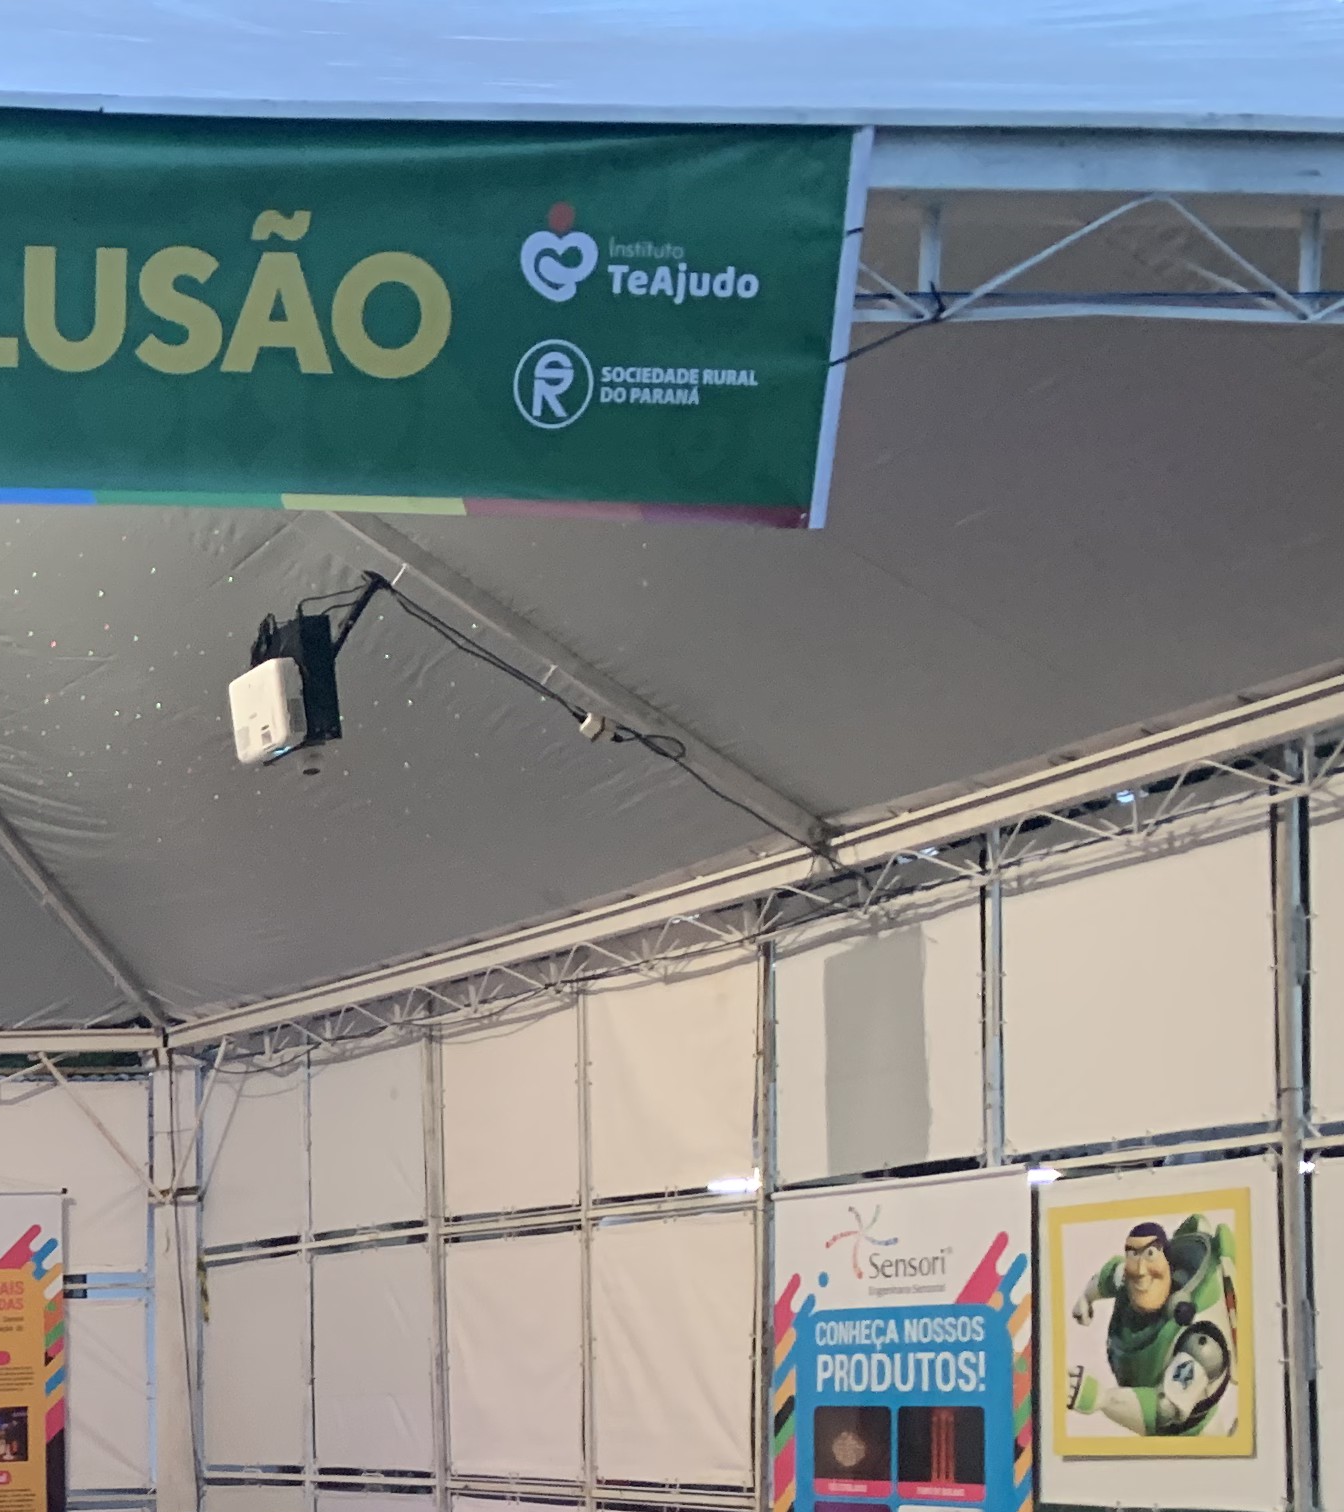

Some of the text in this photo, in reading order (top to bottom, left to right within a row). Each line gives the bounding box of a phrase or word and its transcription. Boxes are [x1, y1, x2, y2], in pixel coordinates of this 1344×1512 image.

[609, 237, 684, 260] Instituto
[607, 262, 759, 304] TeAjudo
[601, 366, 759, 386] SOCIEDADE RURAL
[600, 386, 700, 405] DO PARANÁ
[815, 1315, 985, 1350] CONHEÇA NOSSOS
[816, 1350, 986, 1392] PRODUTOS!
